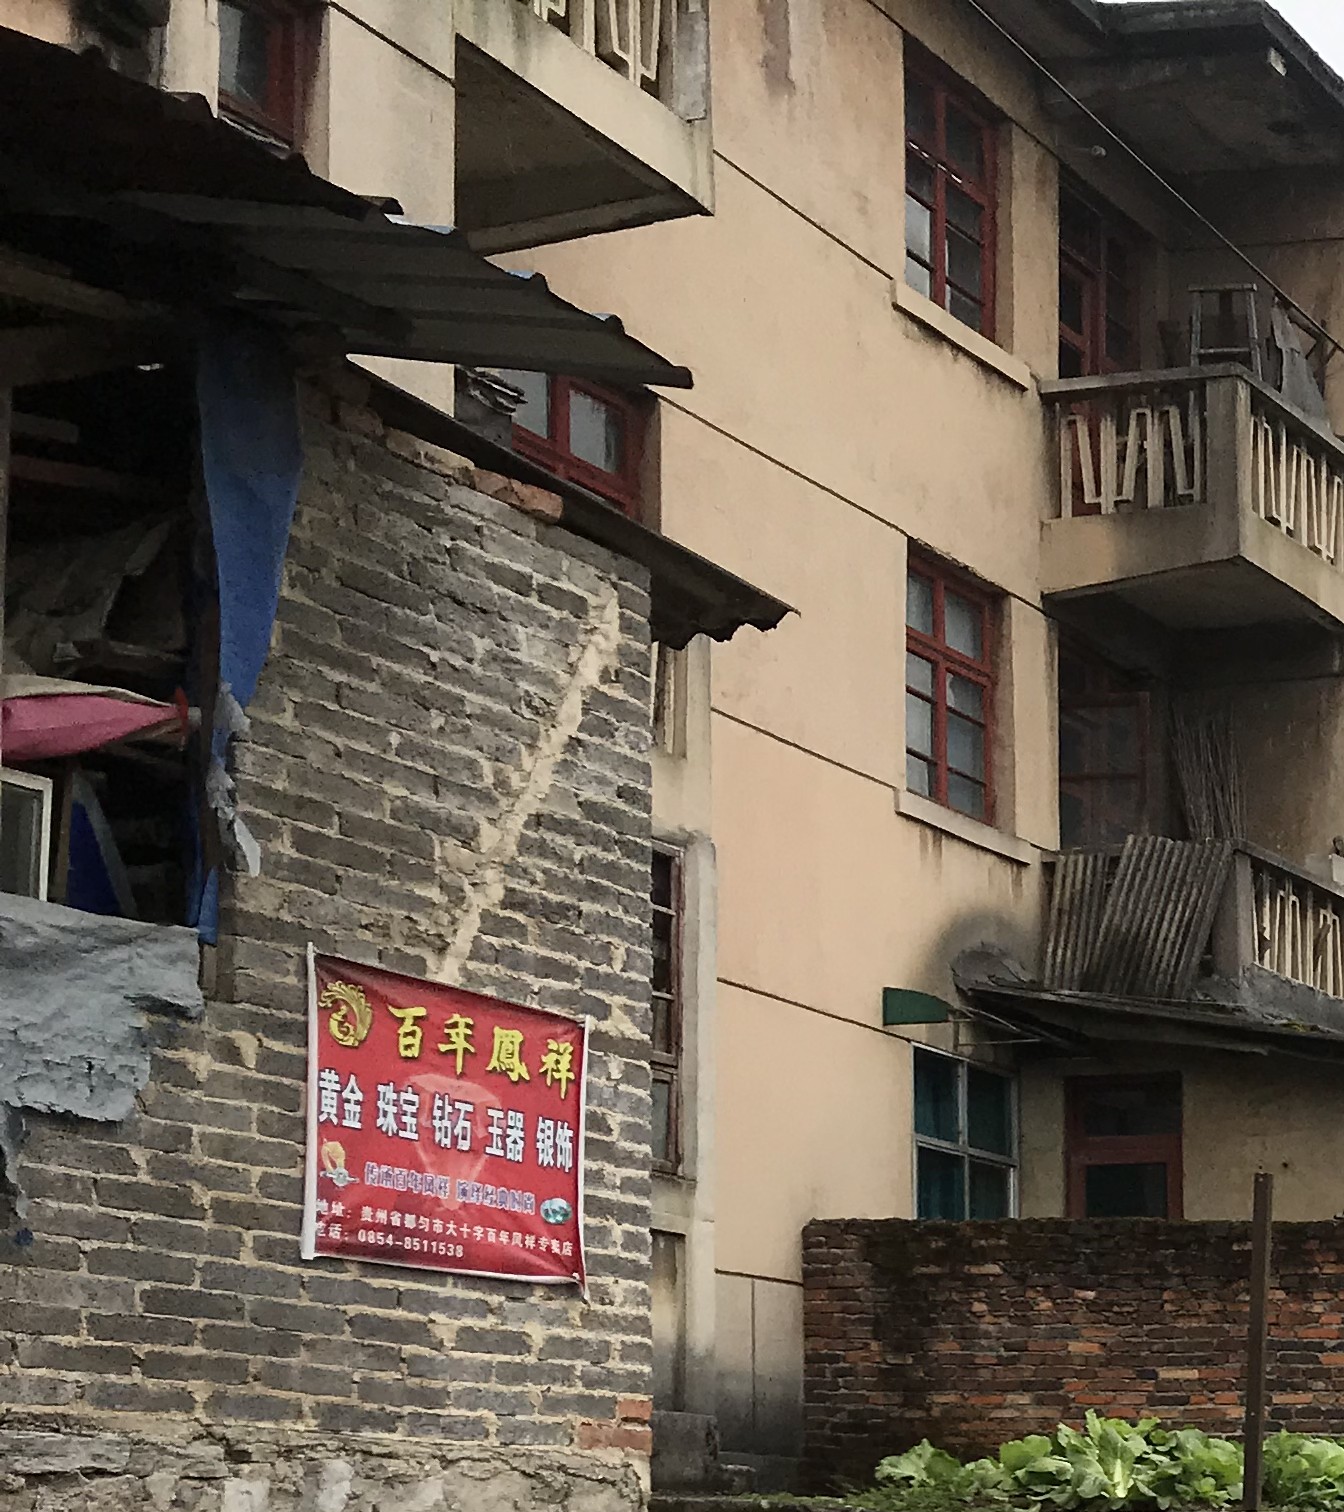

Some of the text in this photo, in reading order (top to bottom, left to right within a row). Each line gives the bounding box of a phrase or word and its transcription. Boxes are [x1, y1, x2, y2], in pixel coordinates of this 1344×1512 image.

[318, 1068, 574, 1174] 黄金 珠宝 钻石 玉器 银饰
[357, 1229, 464, 1258] 0854-8511538
